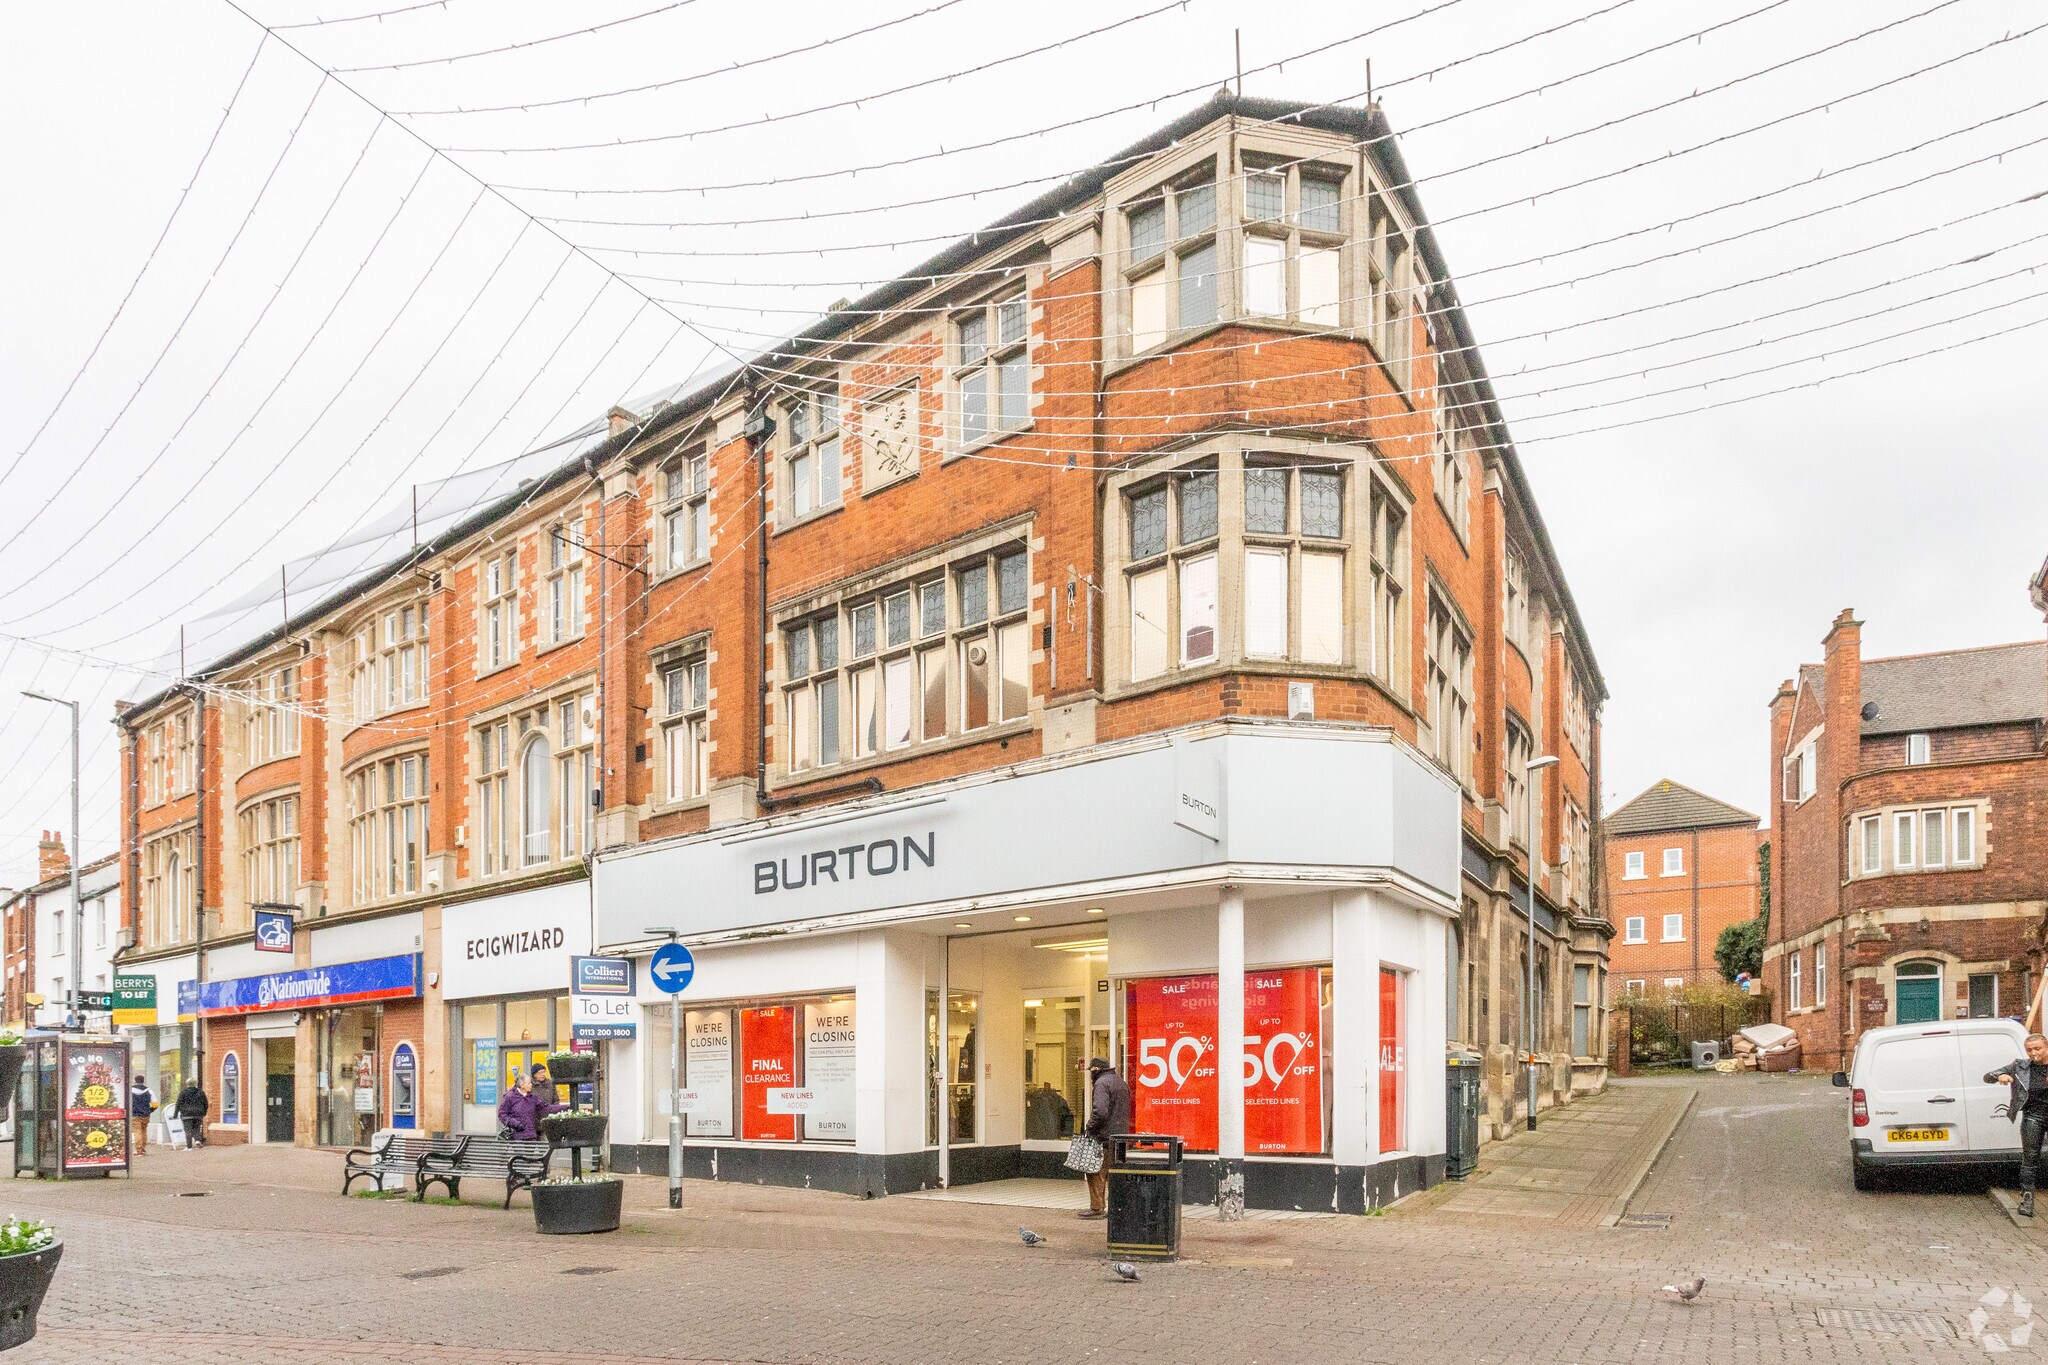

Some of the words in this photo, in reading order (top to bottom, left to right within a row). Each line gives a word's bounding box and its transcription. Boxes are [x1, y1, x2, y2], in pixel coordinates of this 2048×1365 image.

[1182, 793, 1217, 818] BURTON
[754, 831, 935, 895] BURTON
[467, 927, 564, 960] ECIGWIZARD
[584, 965, 624, 976] Colliers
[115, 979, 154, 988] BERRYS
[271, 971, 331, 1000] Nationwide
[1162, 984, 1186, 994] SALE
[1256, 979, 1283, 989] SALE
[120, 991, 133, 999] TO
[134, 991, 149, 999] LET
[580, 998, 599, 1015] To
[606, 999, 630, 1015] Let
[760, 1009, 775, 1017] SALE
[816, 1016, 849, 1027] WE'RE
[1175, 1021, 1184, 1029] TO
[695, 1023, 723, 1034] WE'RE
[690, 1036, 728, 1047] CLOSING
[810, 1031, 855, 1042] CLOSING
[1138, 1035, 1215, 1091] 50%
[1195, 1068, 1215, 1077] OFF
[1380, 1045, 1404, 1072] ALE
[752, 1059, 784, 1071] FINAL
[1293, 1066, 1315, 1076] OFF
[745, 1073, 791, 1083] CLEARANCE
[88, 1088, 105, 1096] 1/2
[1280, 1097, 1300, 1105] LINES
[1891, 1131, 1919, 1140] CK64
[1922, 1130, 1944, 1139] GYD
